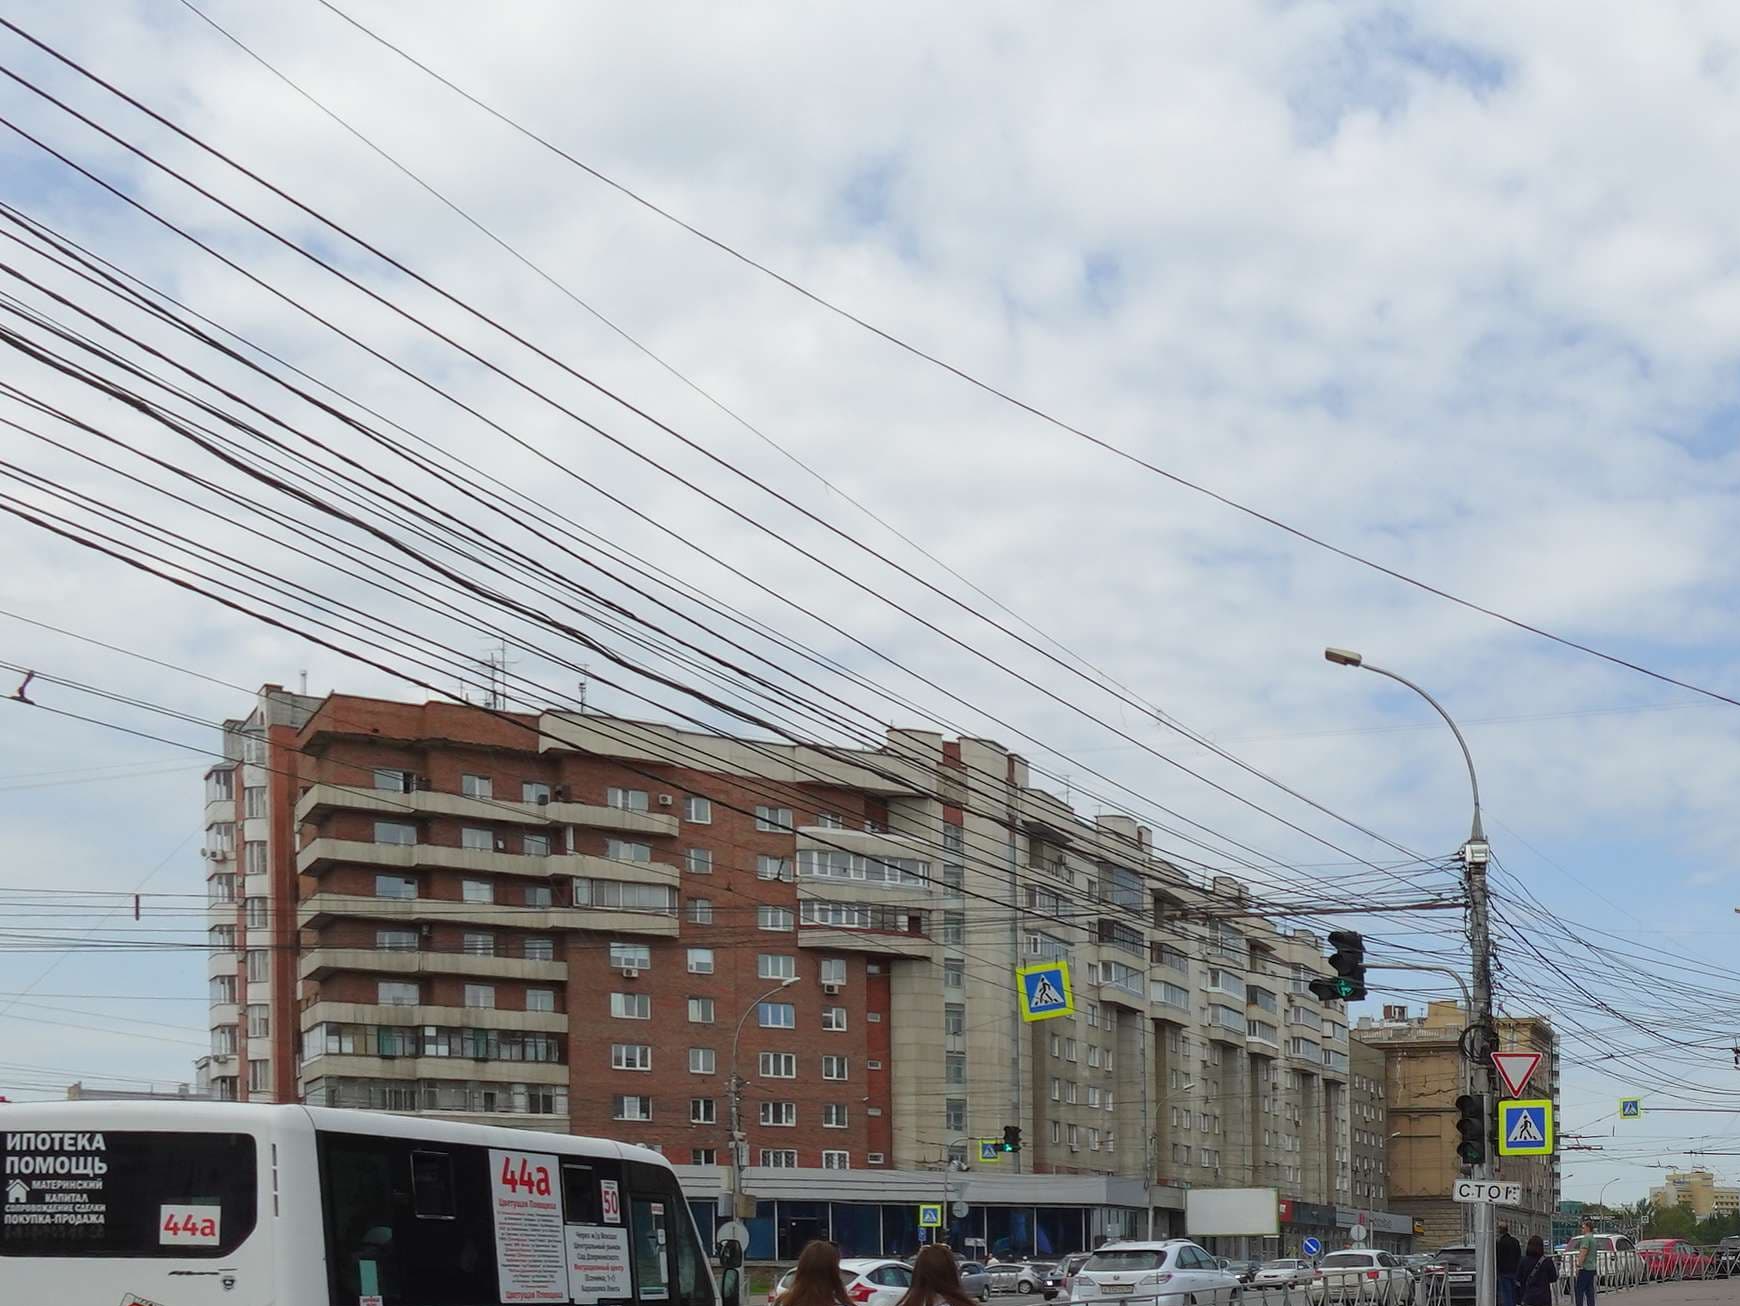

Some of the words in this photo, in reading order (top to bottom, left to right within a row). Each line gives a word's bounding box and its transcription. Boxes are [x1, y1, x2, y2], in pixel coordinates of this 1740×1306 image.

[6, 1132, 106, 1151] ИПОТЕКА
[5, 1156, 108, 1177] ПОМОЩЬ
[501, 1156, 551, 1196] 44а
[31, 1178, 103, 1189] МАТЕРИНСКИЙ
[44, 1193, 89, 1202] КАПИТАЛ
[603, 1190, 619, 1214] 50
[4, 1203, 74, 1213] СОПРОВОЖДЕНИЕ
[75, 1203, 106, 1212] СДЕЛКИ
[4, 1214, 105, 1225] ПОКУПКА-ПРОДАЖА
[163, 1213, 216, 1236] 44а
